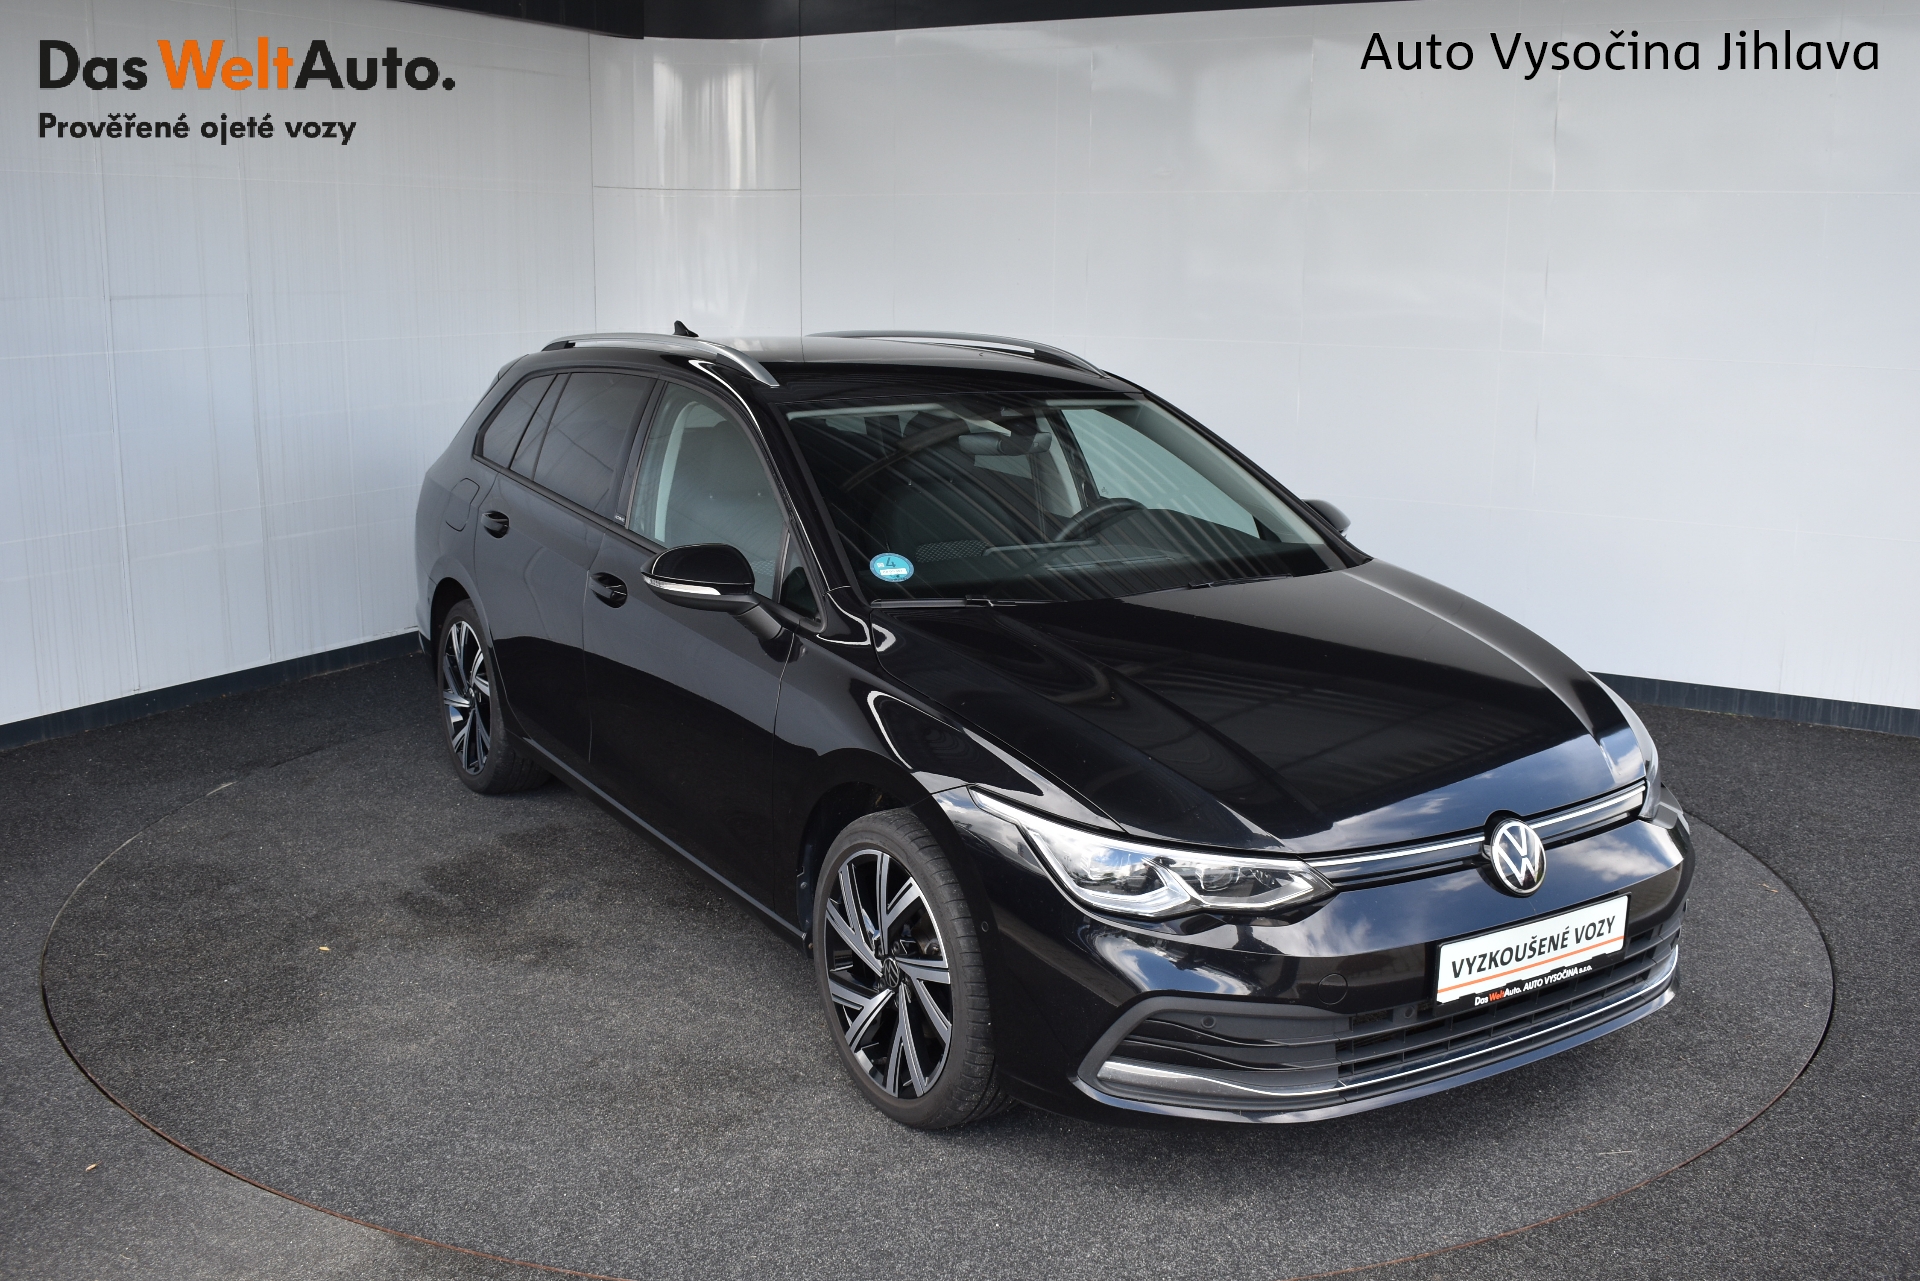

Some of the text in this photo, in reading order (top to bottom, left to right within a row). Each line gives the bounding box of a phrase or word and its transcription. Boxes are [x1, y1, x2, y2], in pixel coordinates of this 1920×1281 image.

[886, 557, 896, 568] 4
[1452, 915, 1616, 978] VYZKOUŠENÉ VOZY
[1474, 996, 1489, 1006] Das
[1523, 978, 1543, 992] AUTO
[1544, 966, 1579, 985] VYSOČINA
